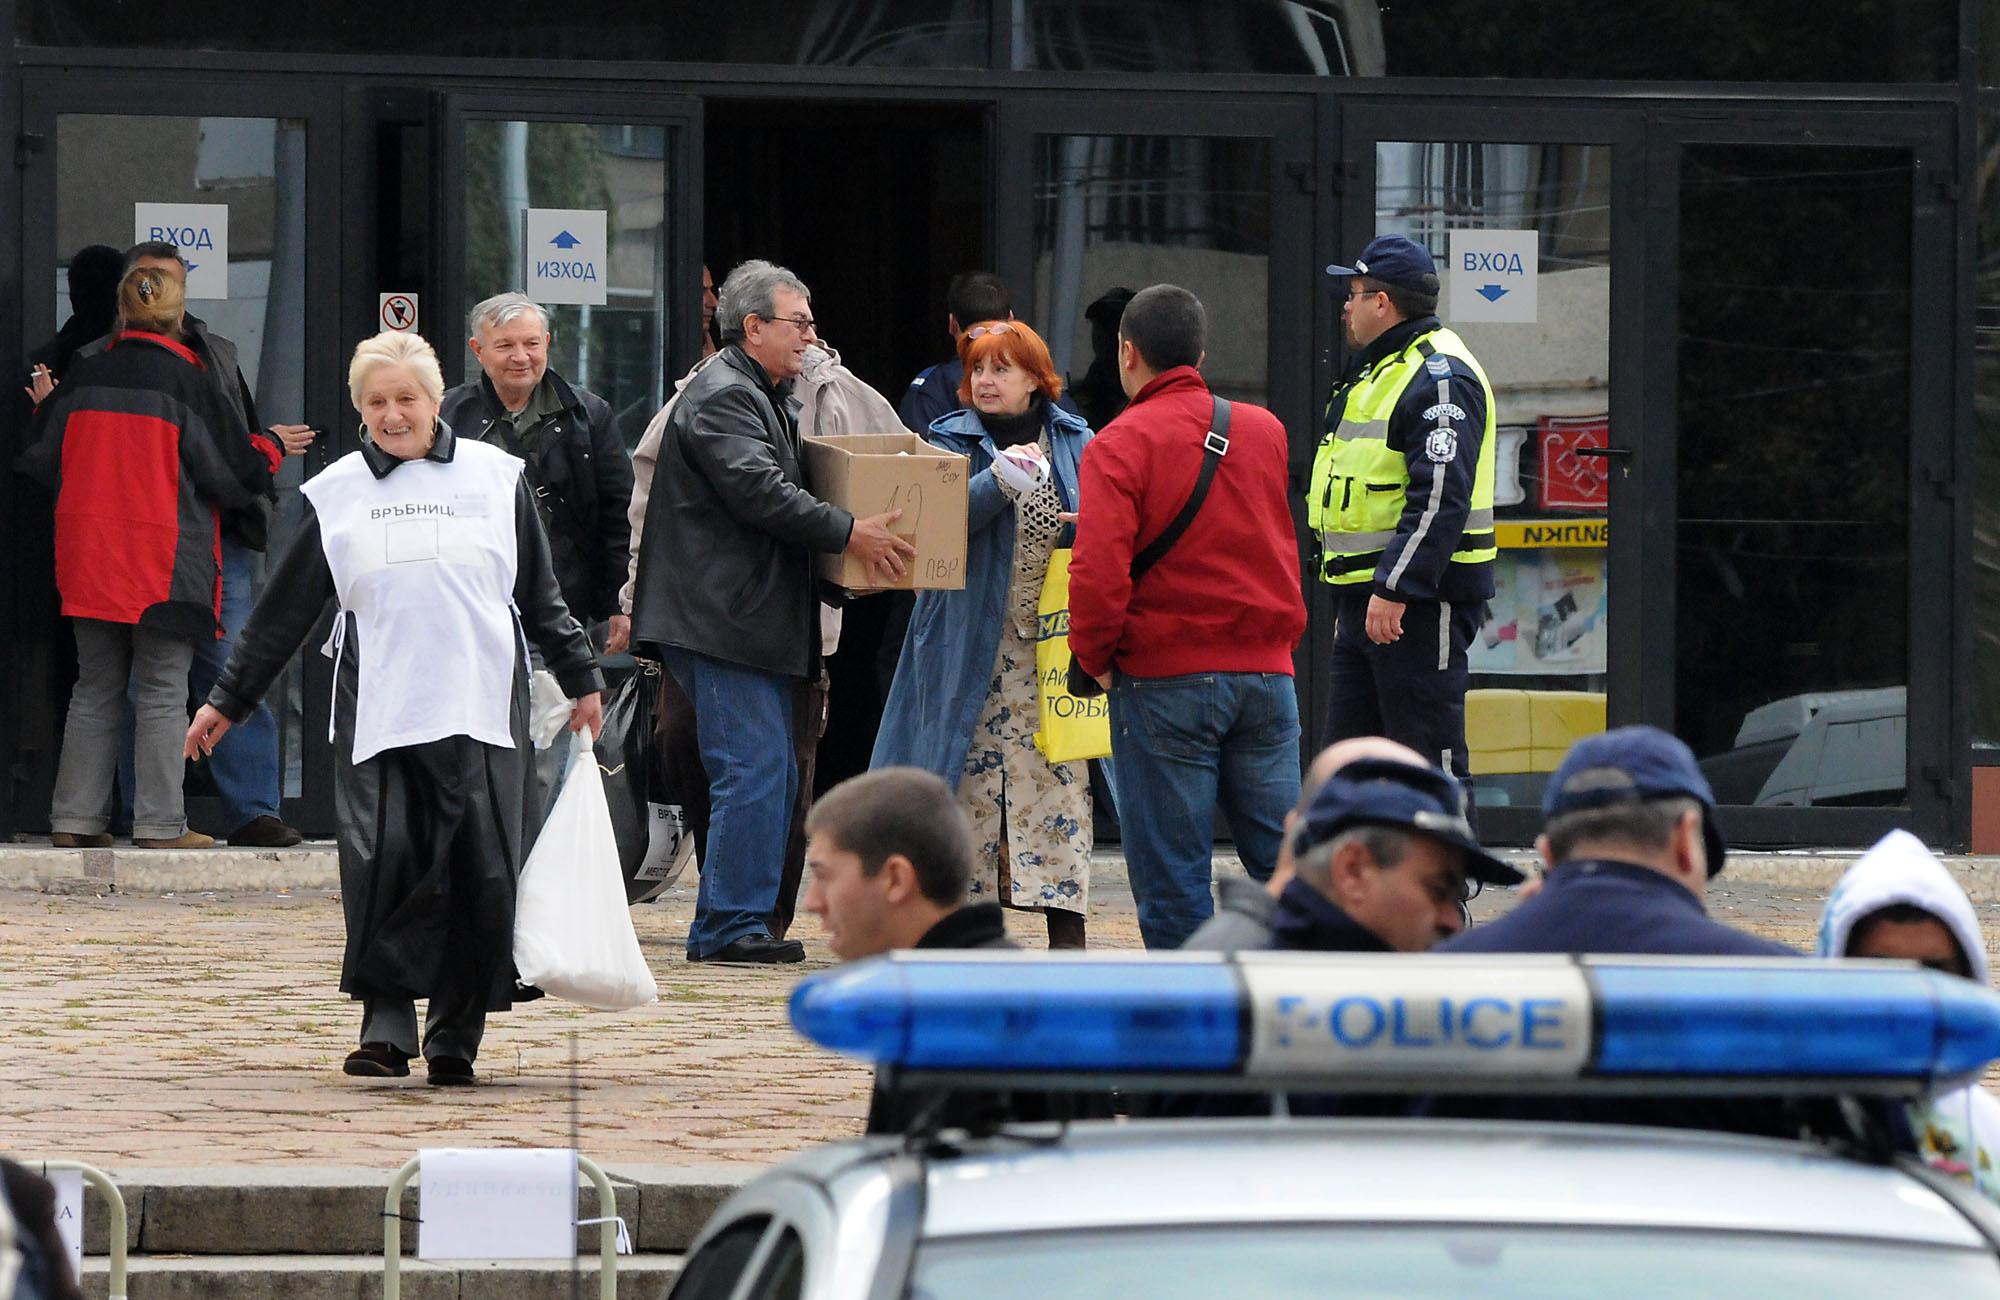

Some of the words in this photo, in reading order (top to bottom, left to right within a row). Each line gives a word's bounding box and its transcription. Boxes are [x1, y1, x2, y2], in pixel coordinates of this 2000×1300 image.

[150, 226, 213, 250] ВХОД
[537, 261, 597, 282] ИЗХОД
[1464, 252, 1523, 276] ВХОД
[370, 503, 455, 519] ВРЪБНИЦ
